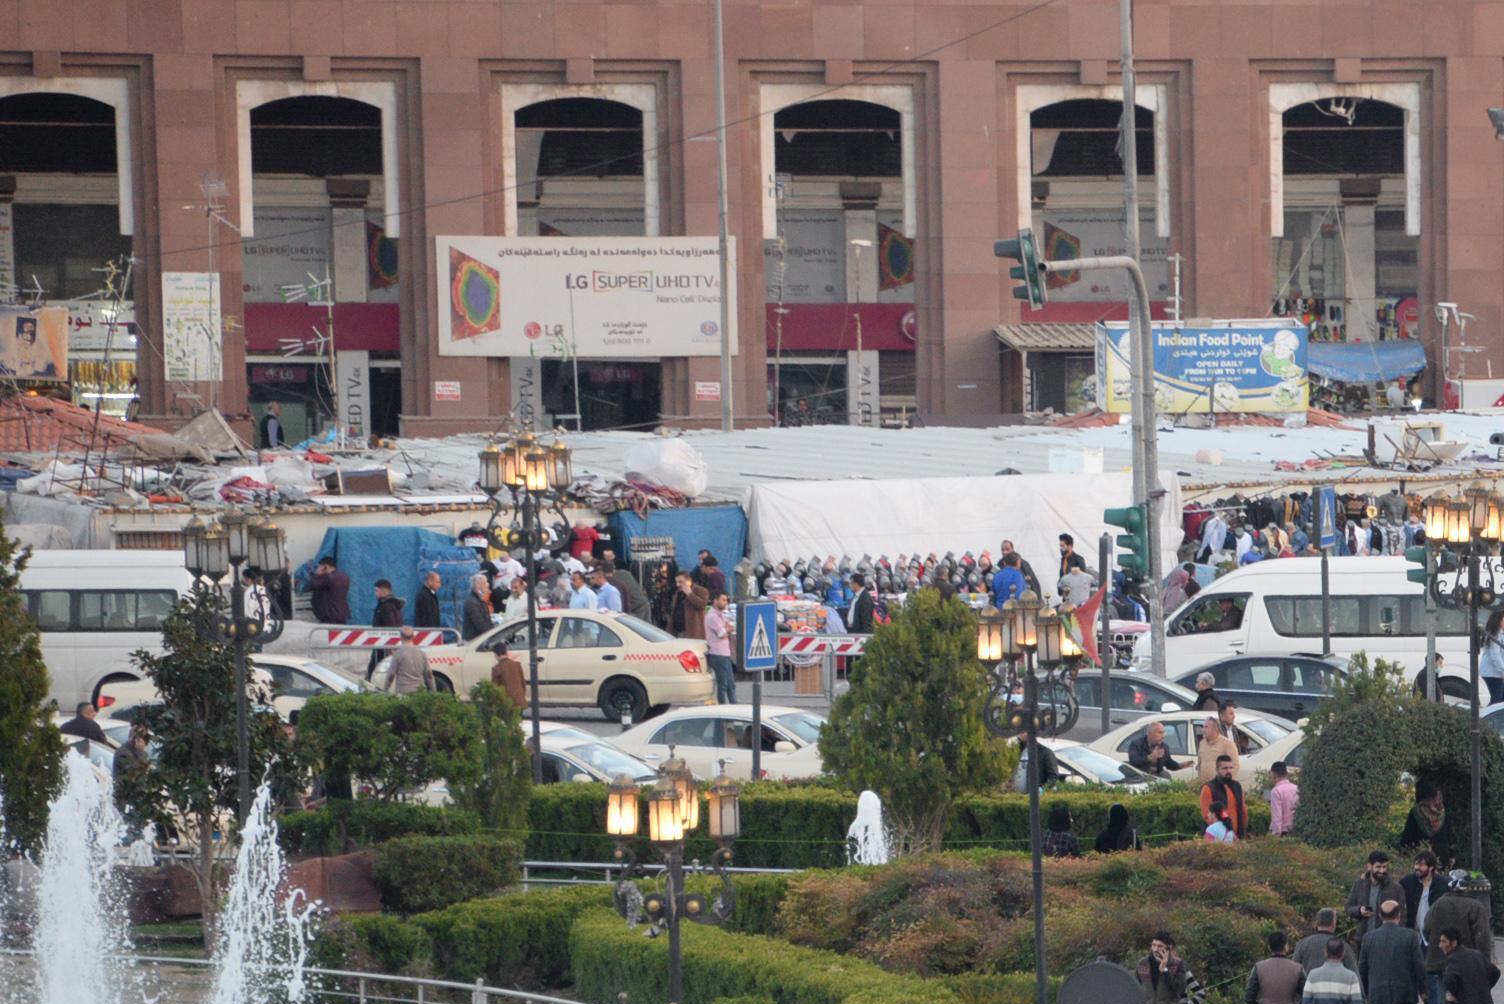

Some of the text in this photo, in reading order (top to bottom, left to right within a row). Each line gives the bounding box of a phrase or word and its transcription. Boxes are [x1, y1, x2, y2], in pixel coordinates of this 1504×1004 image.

[565, 274, 588, 290] LG
[598, 275, 649, 288] SUPER
[1158, 333, 1264, 346] Indian Food Point
